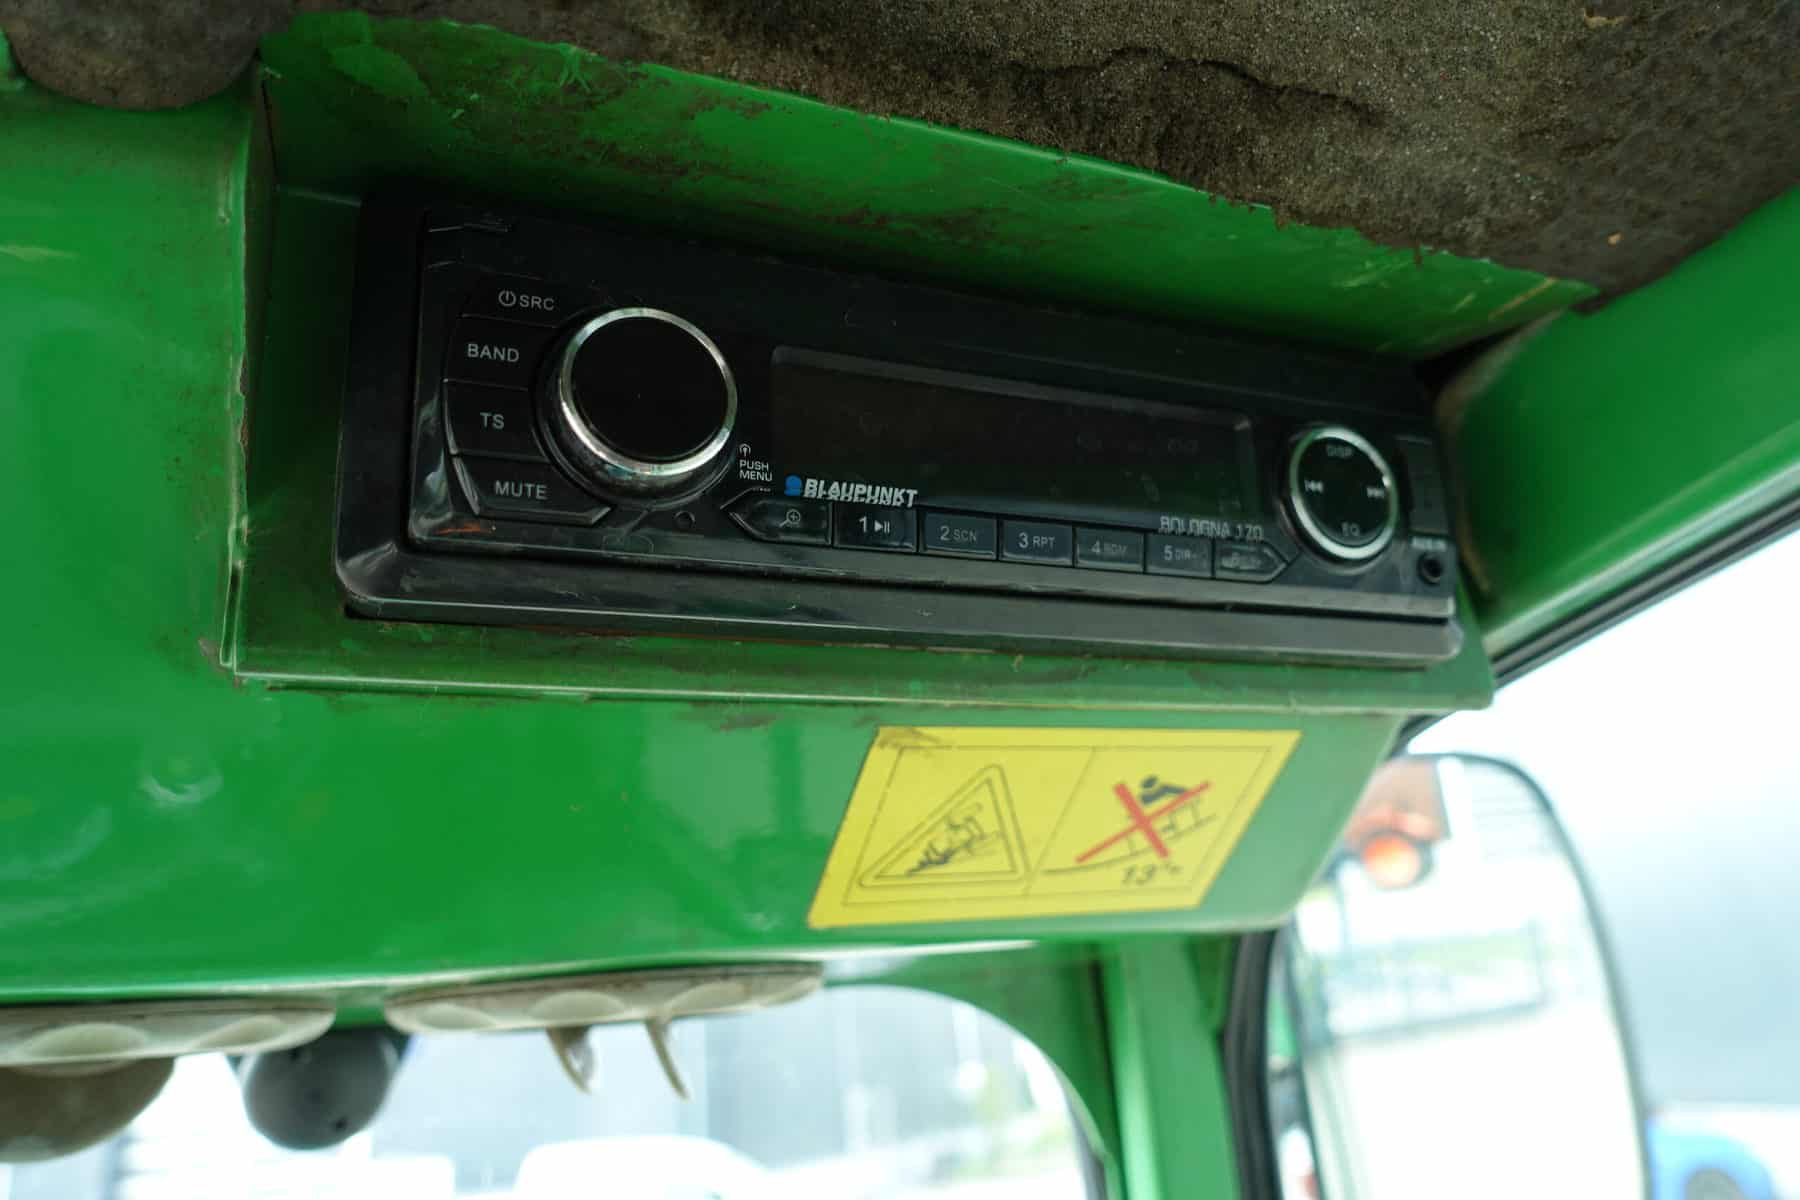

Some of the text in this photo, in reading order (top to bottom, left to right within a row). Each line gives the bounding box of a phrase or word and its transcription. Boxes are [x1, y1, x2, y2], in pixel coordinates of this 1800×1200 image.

[520, 294, 555, 311] SRC
[467, 343, 520, 363] BAND
[480, 412, 505, 430] TS
[738, 459, 769, 472] PUSH
[738, 470, 773, 482] MENU
[495, 480, 548, 501] MUTE
[802, 478, 919, 508] BLAUPUNKT
[858, 516, 868, 533] 1
[1159, 515, 1231, 538] BOLOGNA
[940, 525, 977, 543] 2 SCN
[1018, 532, 1056, 549] 3 RPT
[1091, 540, 1101, 554] 4
[1164, 545, 1174, 561] 5
